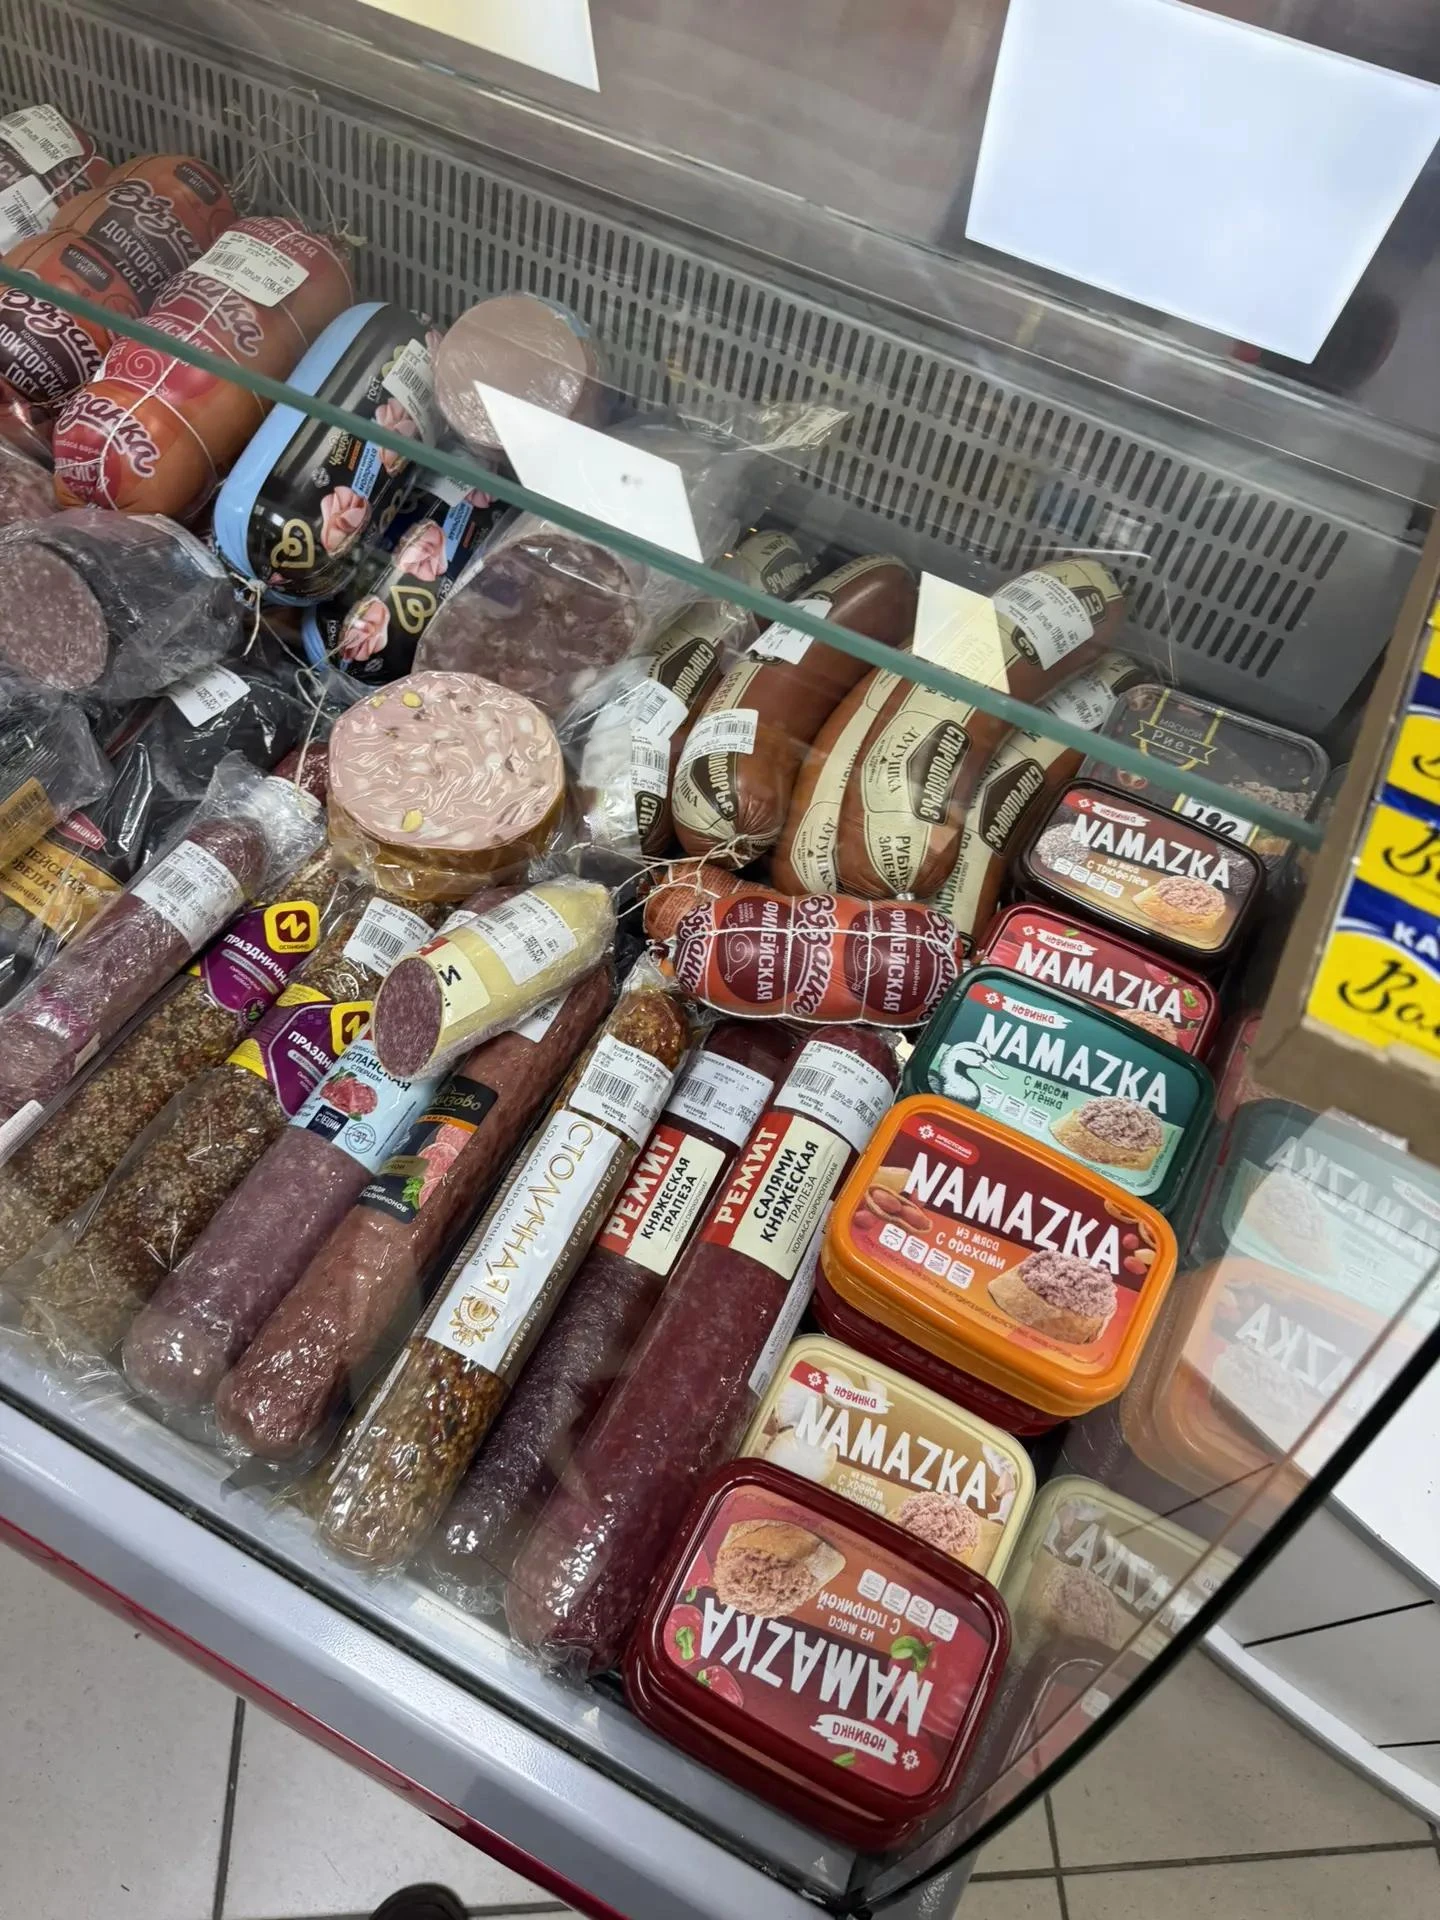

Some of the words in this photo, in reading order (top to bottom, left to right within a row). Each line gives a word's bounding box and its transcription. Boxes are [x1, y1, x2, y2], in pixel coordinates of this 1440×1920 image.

[107, 178, 204, 268] Вяза
[5, 360, 39, 395] ГОСТ
[366, 376, 382, 402] ГОСТ
[920, 726, 966, 820] СТАРОДВОРЬЕ
[1152, 729, 1197, 754] Риет
[986, 763, 1044, 849] СТАРОДВОРЬЕ
[1070, 813, 1231, 889] NAMAZKA
[1015, 942, 1182, 1023] NAMAZKA
[974, 1013, 1168, 1115] NAMAZKA
[1023, 1075, 1032, 1087] С
[1033, 1081, 1069, 1101] мясом
[1023, 1088, 1062, 1111] утёнка
[525, 1124, 560, 1177] КОЛБАСА
[604, 1134, 675, 1240] РЕМИТ
[713, 1127, 778, 1225] РЕМИТ
[753, 1149, 797, 1220] САЛЯМИ
[760, 1140, 820, 1244] КНЯЖЕСКАЯ
[486, 1120, 594, 1295] СТОЛИЧНАЯ
[570, 1148, 626, 1249] ГРОДНЕНСКИЙ
[640, 1157, 691, 1240] КНЯЖЕСКАЯ
[658, 1175, 698, 1234] ТРАПЕЗА
[786, 1176, 818, 1225] ТРАПЕЗА
[791, 1218, 812, 1255] КОЛБАСА
[808, 1162, 839, 1221] СЫРОКОПЧЕНАЯ
[903, 1152, 1120, 1275] NAMAZKA
[948, 1237, 1007, 1270] орехами
[795, 1396, 987, 1510] NAMAZKA
[818, 1591, 884, 1628] паприкой
[700, 1597, 933, 1737] NAMAZKA
